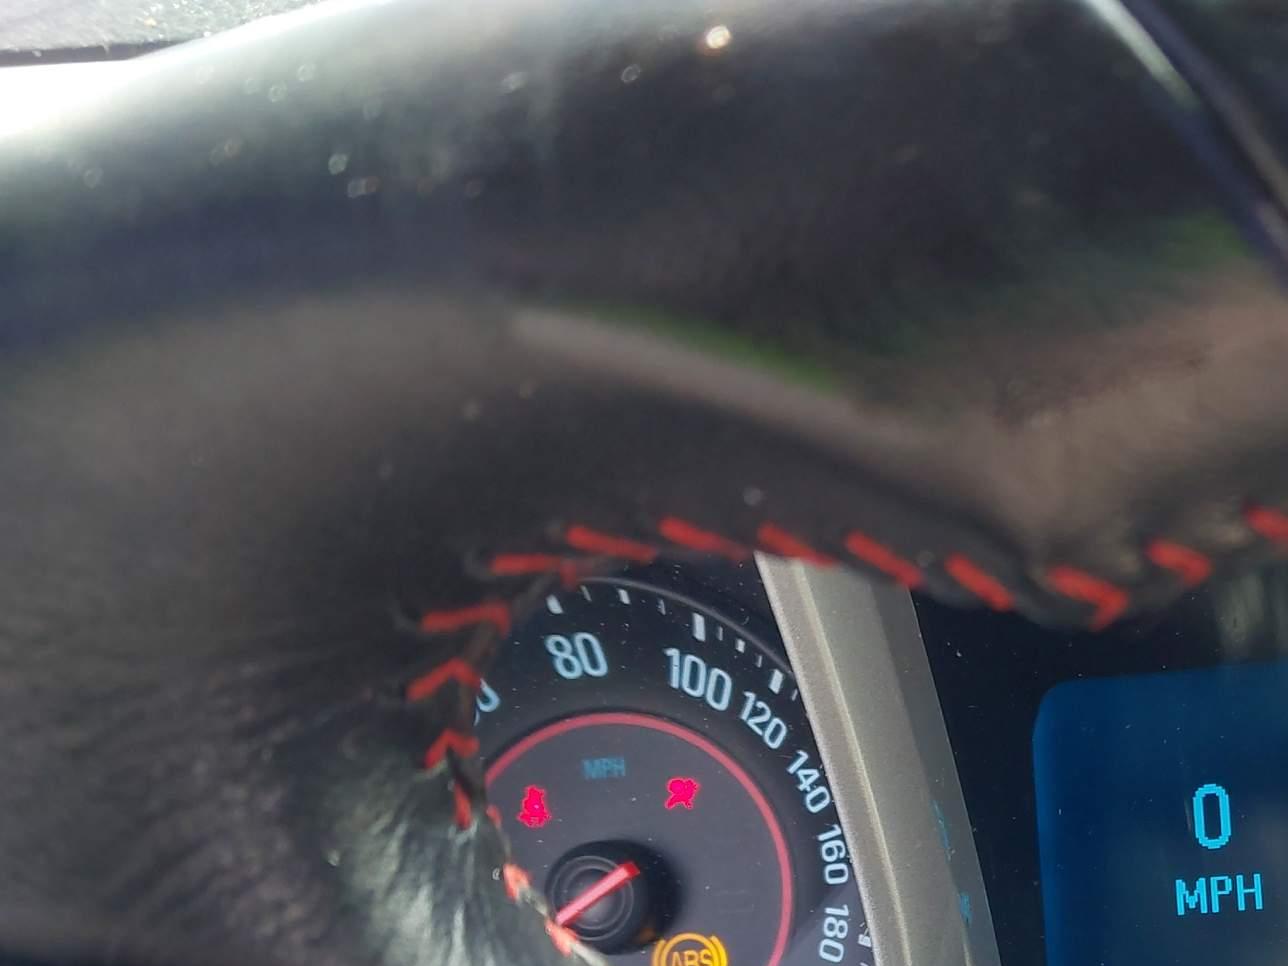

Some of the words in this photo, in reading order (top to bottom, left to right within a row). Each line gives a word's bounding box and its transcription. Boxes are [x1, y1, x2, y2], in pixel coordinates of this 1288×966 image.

[545, 632, 609, 680] 80
[664, 647, 734, 711] 100
[741, 690, 789, 750] 120
[582, 757, 626, 779] MPH
[785, 750, 831, 814] 140
[1192, 783, 1232, 849] 0
[817, 824, 850, 886] 160
[1175, 873, 1264, 914] MPH
[819, 903, 850, 964] 180
